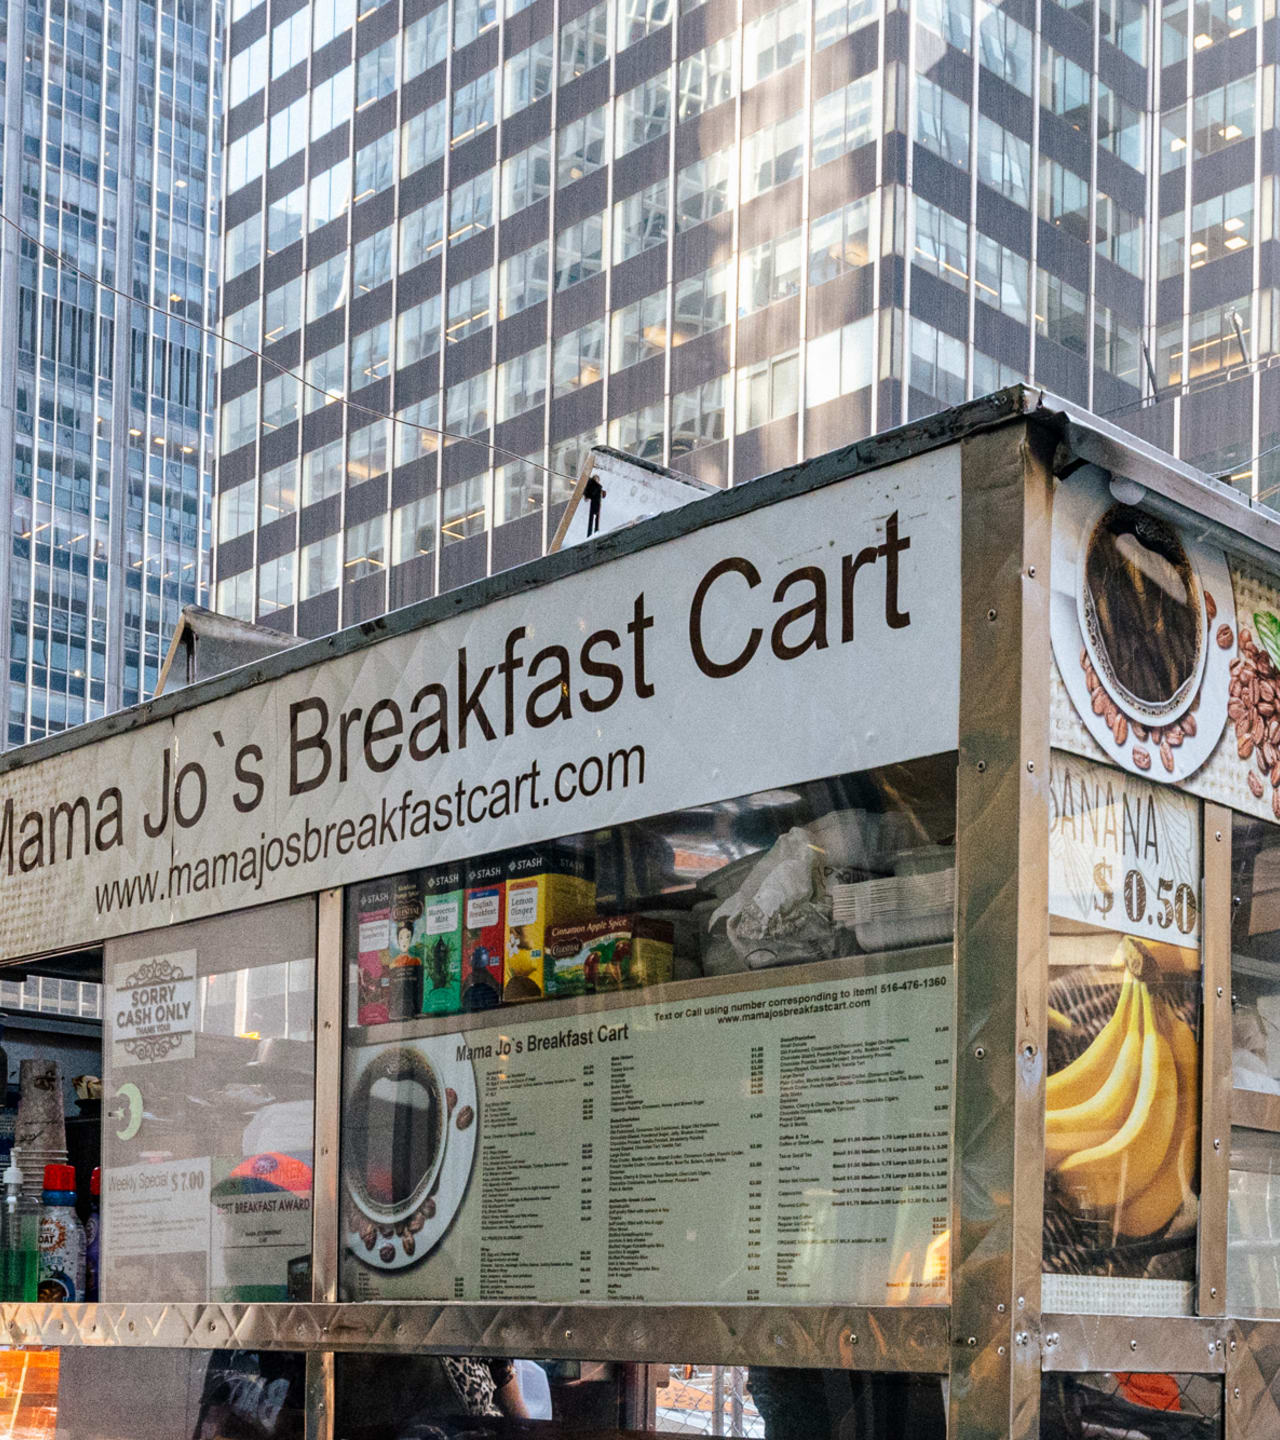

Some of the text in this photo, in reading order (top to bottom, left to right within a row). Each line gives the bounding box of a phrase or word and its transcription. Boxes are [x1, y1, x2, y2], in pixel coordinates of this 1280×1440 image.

[289, 592, 655, 796] Breakfast
[689, 510, 911, 679] Cart
[95, 744, 645, 914] www.mamajosbreakfastcart.com
[476, 867, 501, 880] STASH
[517, 857, 543, 870] STASH
[435, 873, 459, 886] STASH
[367, 892, 389, 904] STASH
[1123, 870, 1197, 934] 0.50
[551, 918, 628, 937] Cinnamon Apple Spice
[131, 984, 176, 1007] SORRY
[654, 1012, 673, 1021] Text
[674, 1011, 683, 1019] or
[685, 1008, 702, 1018] Call
[704, 1006, 729, 1017] using
[731, 1000, 766, 1013] number
[768, 992, 838, 1008] corresponding
[840, 990, 851, 999] to
[880, 976, 947, 993] 516-476-1360
[116, 1001, 191, 1028] CASH ONLY
[717, 999, 871, 1025] www.mamajosbreakfastcart.com
[456, 1043, 492, 1062] Mama
[527, 1029, 594, 1051] Breakfast
[597, 1023, 629, 1042] Cart
[108, 1174, 137, 1193] Weekly
[139, 1172, 168, 1190] Special
[181, 1170, 205, 1191] 7.00
[235, 1200, 277, 1214] BREAKFAST
[279, 1198, 310, 1211] AWARD
